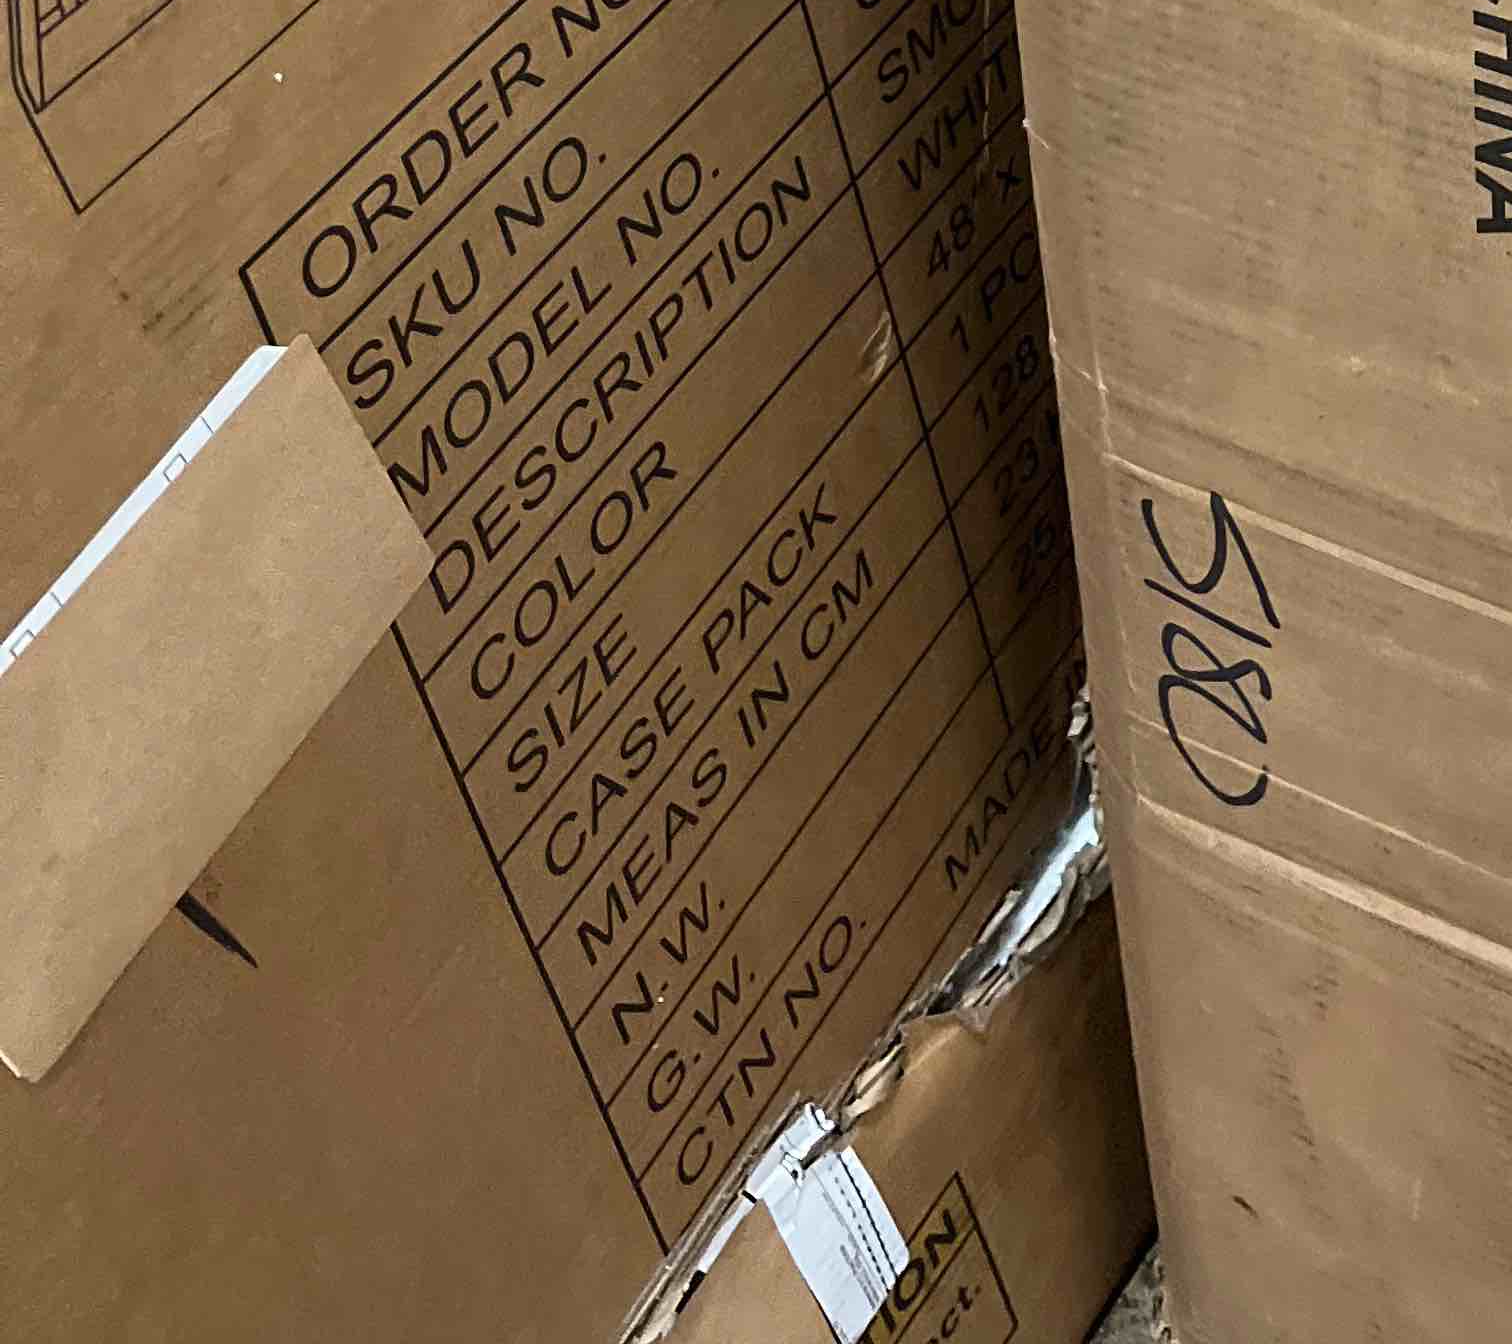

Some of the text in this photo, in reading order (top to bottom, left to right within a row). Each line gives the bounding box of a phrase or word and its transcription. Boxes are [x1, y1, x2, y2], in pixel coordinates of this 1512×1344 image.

[302, 41, 546, 301] ORDER
[347, 241, 480, 410] SKU
[495, 134, 607, 253] NO.
[387, 264, 612, 513] MODEL
[616, 151, 719, 266] NO.
[430, 154, 813, 614] DESCRIPTION
[471, 32, 1017, 701] COLOR WHIT
[507, 612, 641, 795] SIZE
[545, 680, 687, 877] CASE
[702, 483, 838, 675] PACK
[574, 757, 730, 967] MEAS
[742, 669, 792, 746] IN
[801, 548, 876, 664] CM
[946, 704, 1055, 891] MADE
[611, 880, 726, 1046] N.W.
[646, 967, 755, 1115] G.W.
[678, 912, 868, 1187] CTN NO.
